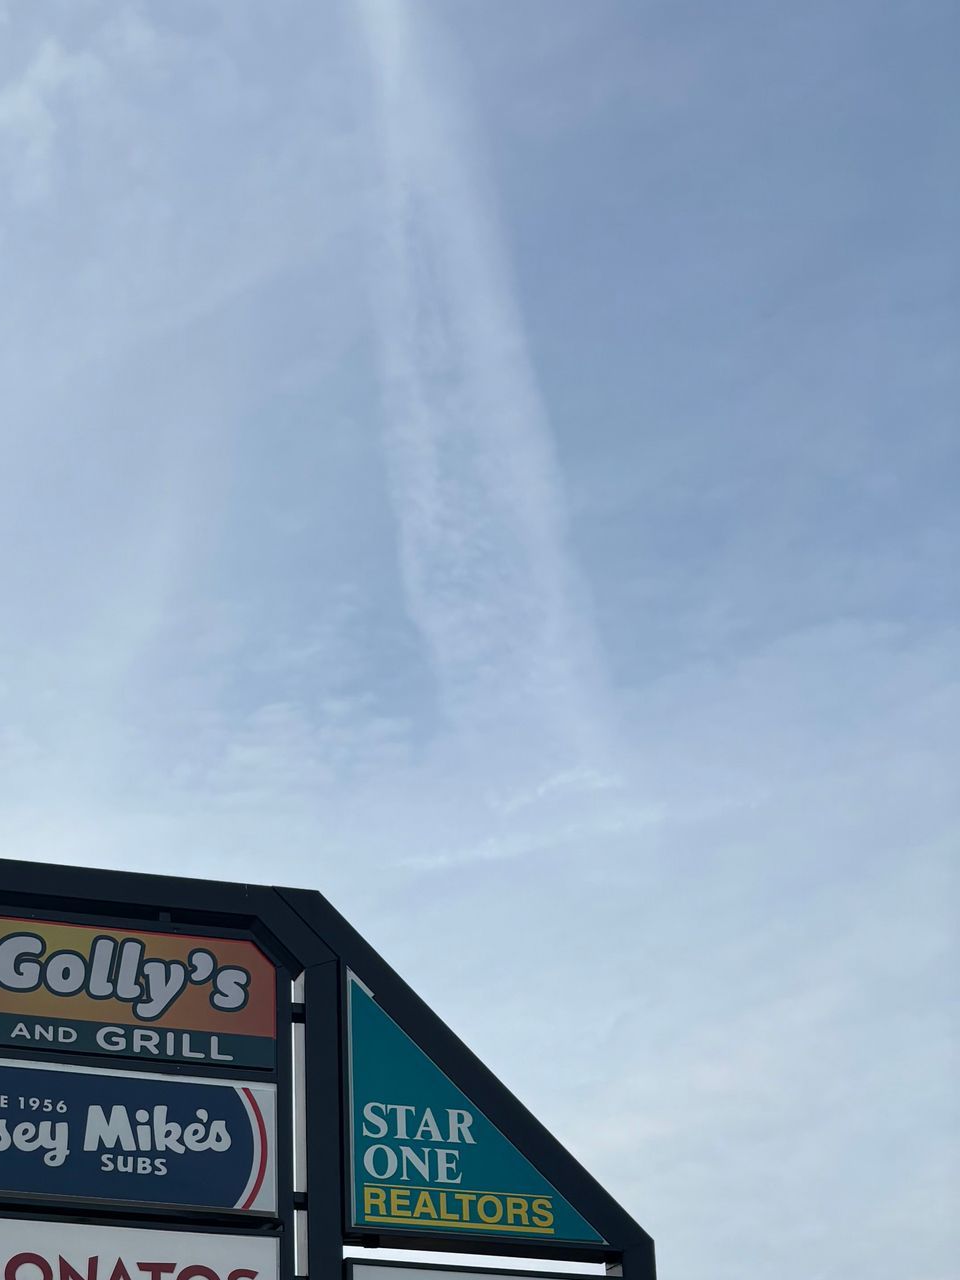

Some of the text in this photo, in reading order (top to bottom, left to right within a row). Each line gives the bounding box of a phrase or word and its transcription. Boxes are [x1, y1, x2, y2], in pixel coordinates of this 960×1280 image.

[10, 1022, 78, 1043] AND
[95, 1026, 235, 1061] GRILL
[18, 1096, 68, 1114] 1956
[362, 1102, 477, 1144] STAR
[83, 1104, 232, 1155] Mike's
[100, 1153, 168, 1176] SUBS
[363, 1144, 463, 1184] ONE
[364, 1187, 554, 1227] REALTORS
